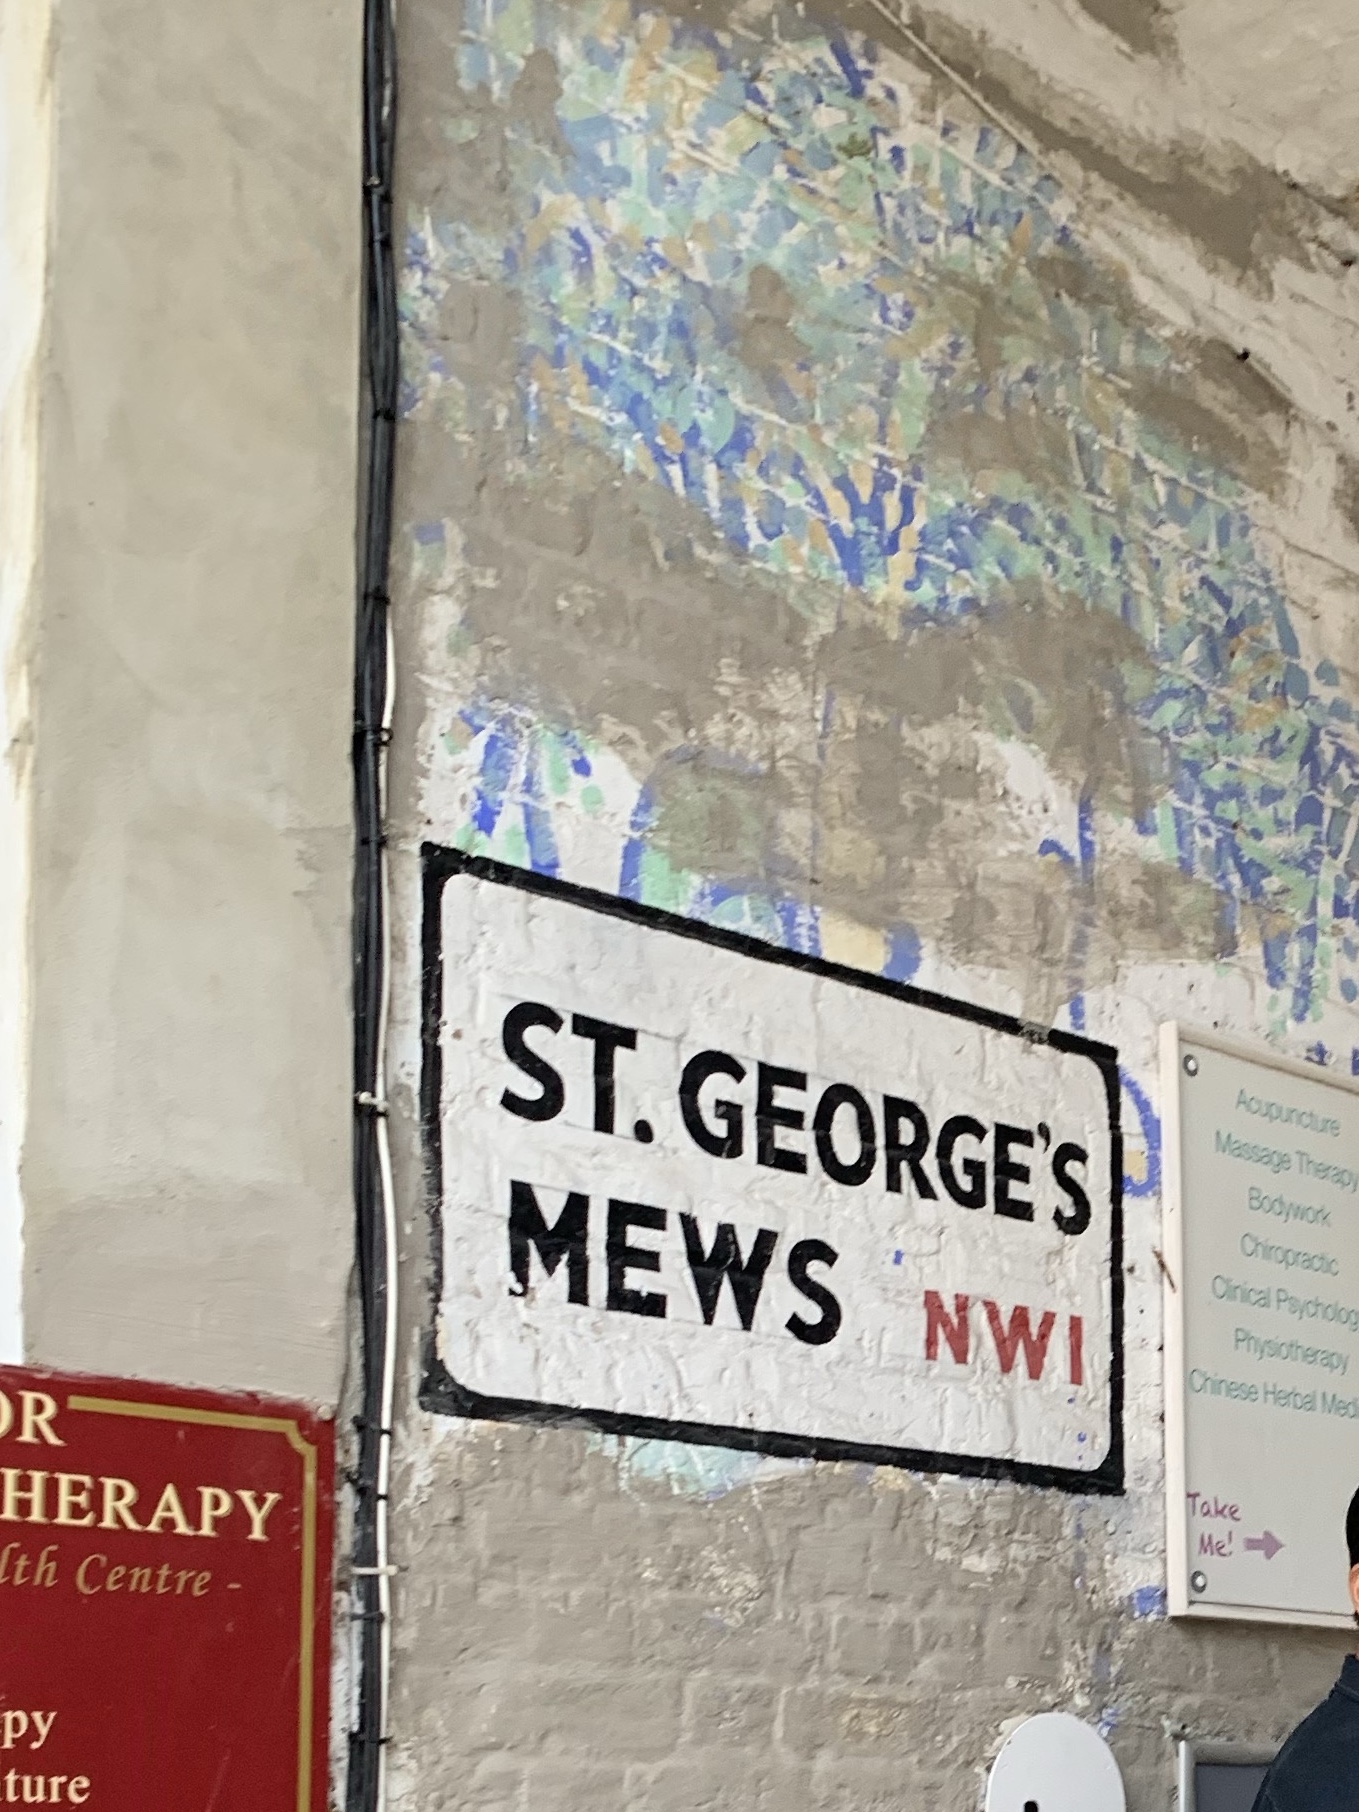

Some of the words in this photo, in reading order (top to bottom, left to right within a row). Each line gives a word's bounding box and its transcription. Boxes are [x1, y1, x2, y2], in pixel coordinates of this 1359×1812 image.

[498, 1001, 654, 1143] ST.
[678, 1050, 1092, 1235] GEORGE'S
[1235, 1088, 1341, 1138] Acupuncture
[1214, 1130, 1292, 1175] Massage
[1297, 1150, 1359, 1193] Therapy
[1248, 1186, 1332, 1227] Bodywork
[508, 1180, 842, 1345] MEWS
[1240, 1232, 1340, 1276] Chiropractic
[1211, 1274, 1271, 1310] Clinical
[1233, 1327, 1350, 1376] Physiotherapy
[1188, 1368, 1259, 1404] Chinese
[1263, 1383, 1317, 1414] Herbal
[0, 1389, 67, 1447] R
[1187, 1492, 1241, 1522] Take
[75, 1553, 213, 1597] Centre
[0, 1708, 58, 1750] py
[0, 1767, 91, 1804] ture
